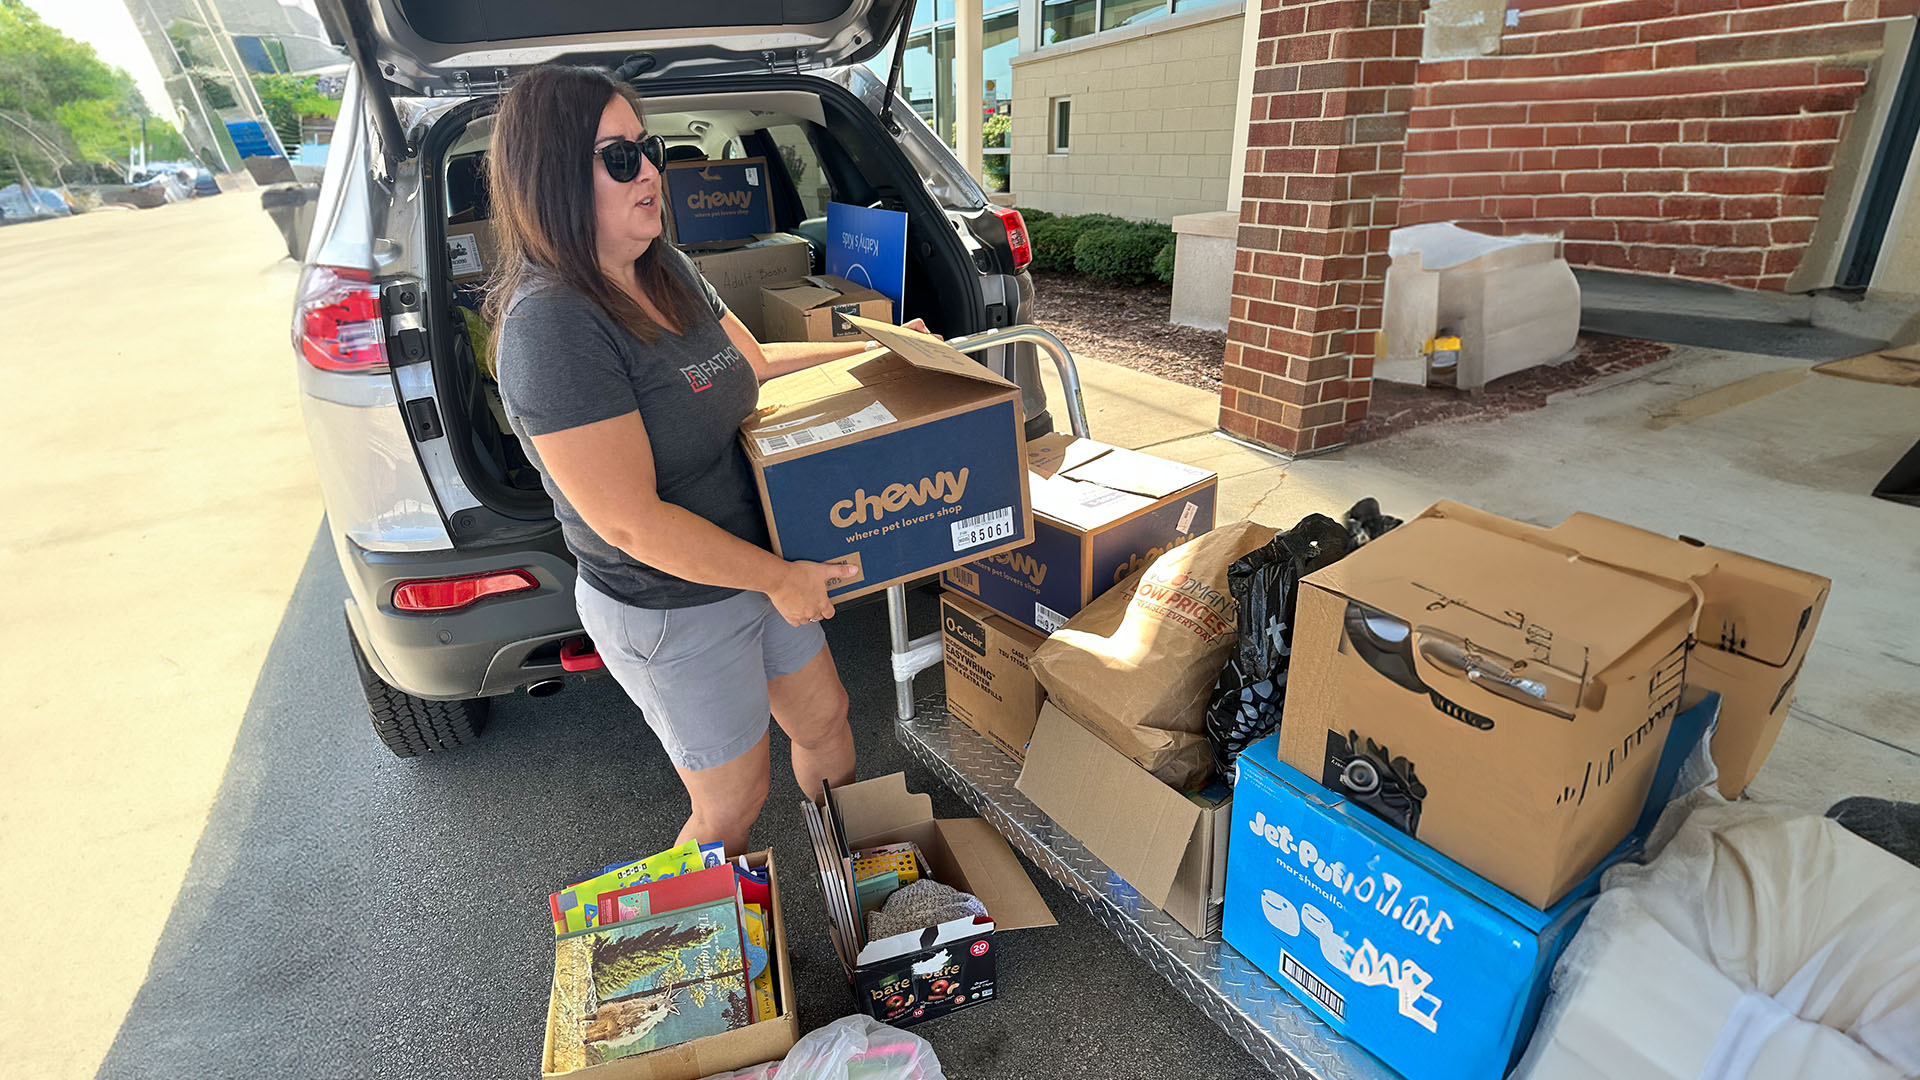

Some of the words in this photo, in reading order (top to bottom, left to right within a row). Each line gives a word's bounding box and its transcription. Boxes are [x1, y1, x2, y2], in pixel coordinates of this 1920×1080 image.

[687, 190, 752, 209] chewy
[842, 231, 855, 250] Kids
[854, 233, 879, 257] Kathy's
[699, 344, 742, 378] FATHO
[829, 467, 970, 528] chewy
[845, 526, 880, 543] where
[881, 520, 901, 536] pet
[902, 512, 935, 529] lovers
[936, 503, 963, 518] shop
[970, 521, 1010, 543] 85061
[1165, 591, 1228, 637] PRICES
[1165, 609, 1196, 630] EVERY
[946, 616, 983, 649] O-Cedar
[697, 913, 710, 934] The
[972, 942, 988, 954] 20
[870, 978, 911, 1000] bare
[914, 1009, 924, 1017] 10
